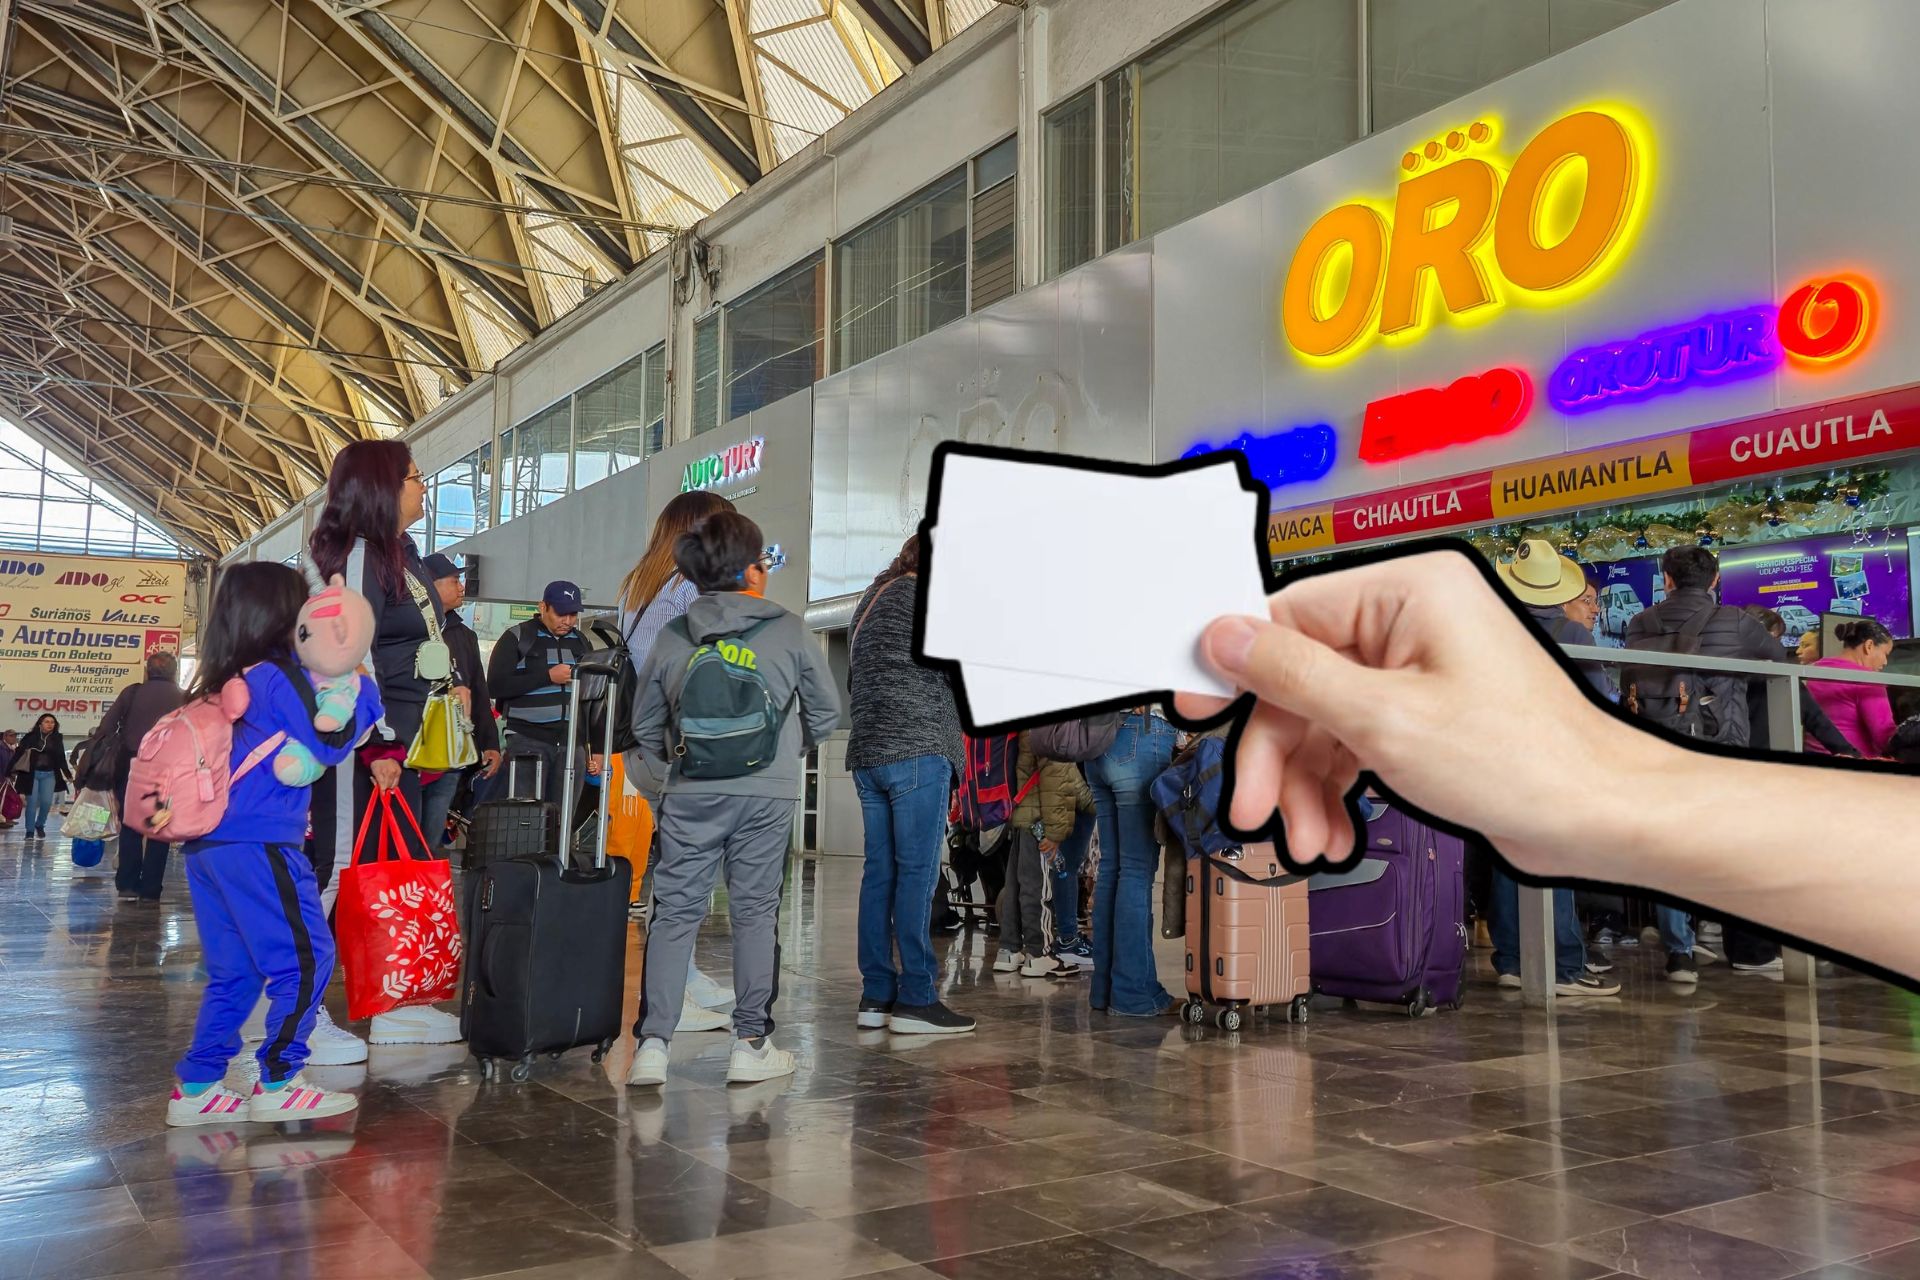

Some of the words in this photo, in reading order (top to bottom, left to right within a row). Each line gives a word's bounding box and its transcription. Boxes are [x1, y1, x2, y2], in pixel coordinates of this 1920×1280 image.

[1283, 111, 1638, 357] ORO
[1551, 313, 1773, 402] OROTUR
[1730, 409, 1894, 463] CUAUTLA
[1503, 450, 1673, 503] HUAMANTLA
[1353, 490, 1462, 531] CHIAUTLA
[1268, 515, 1324, 544] AVACA
[1756, 559, 1785, 568] SERVICIO
[1787, 556, 1818, 565] ESPECIAL
[120, 594, 174, 604] OCC
[30, 607, 91, 621] Surianos
[11, 625, 142, 649] Autobuses
[0, 648, 38, 658] sonas
[41, 648, 66, 659] Con
[69, 650, 112, 661] Boleto
[83, 686, 114, 694] TICKETS
[15, 698, 114, 712] TOURISTE
